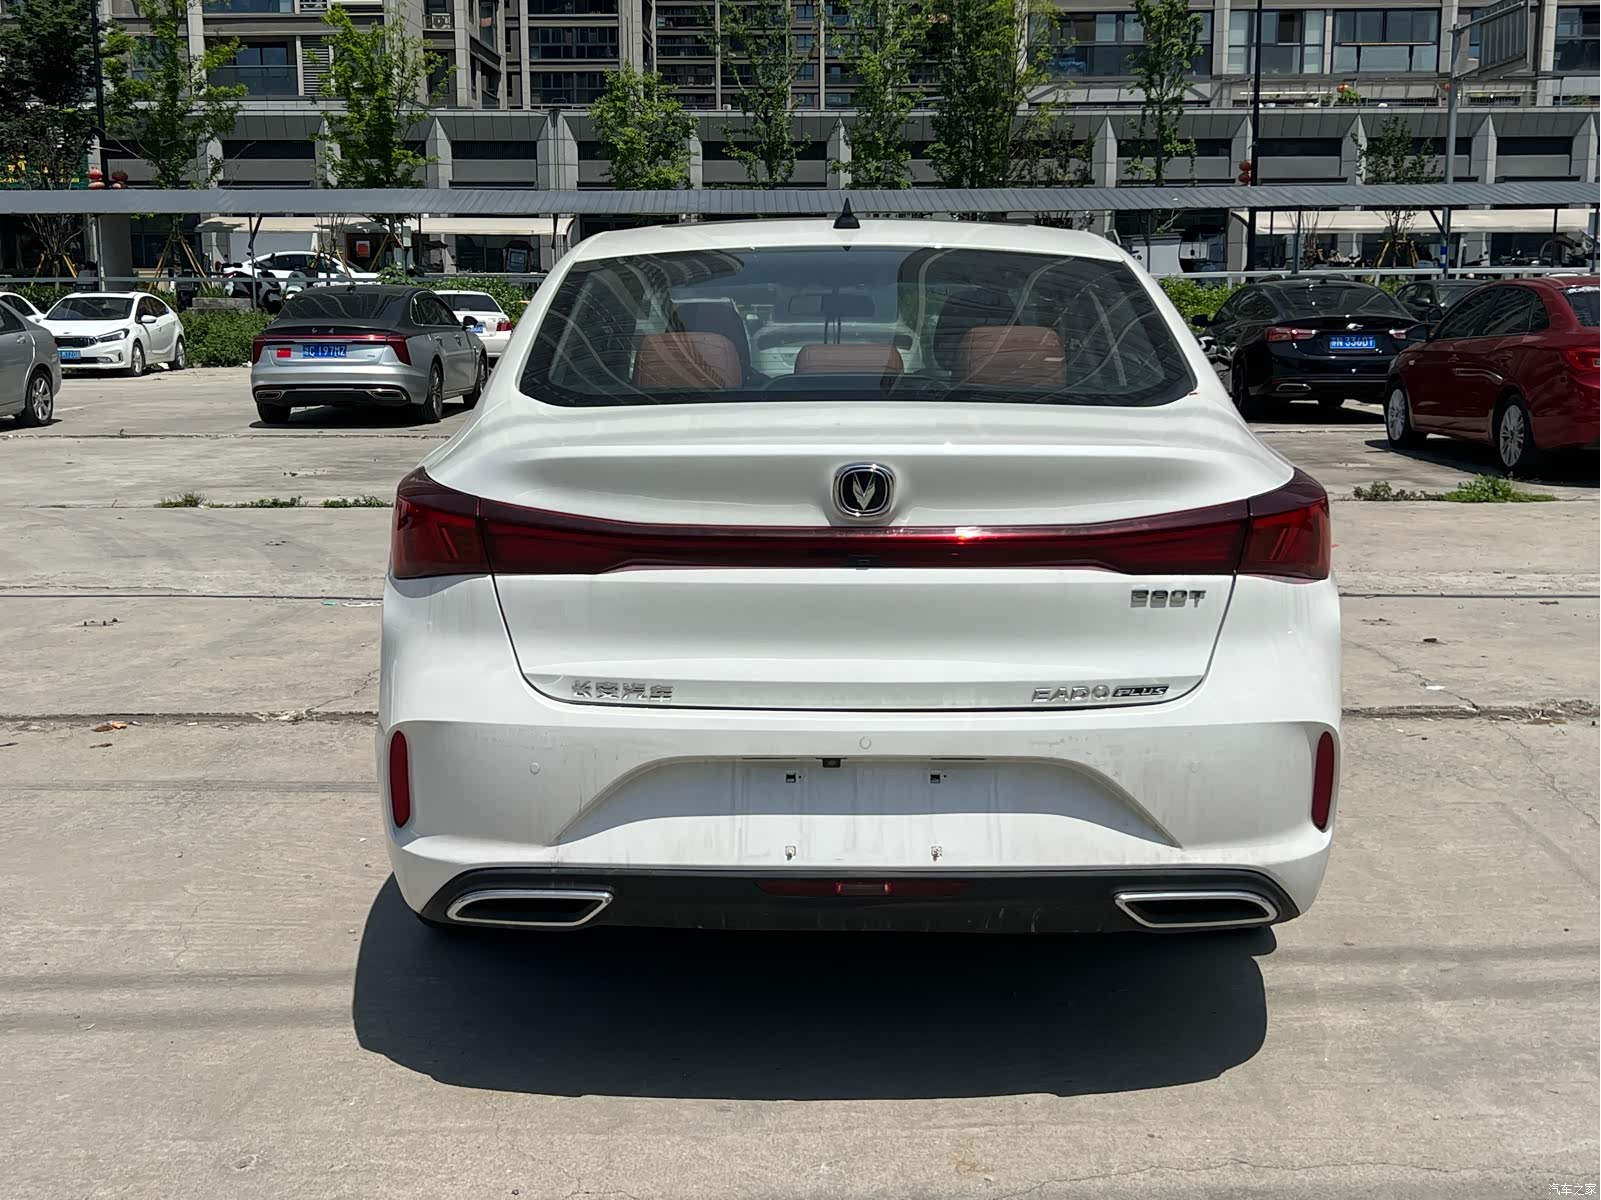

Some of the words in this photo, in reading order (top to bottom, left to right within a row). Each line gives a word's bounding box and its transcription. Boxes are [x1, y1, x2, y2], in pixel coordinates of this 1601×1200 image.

[571, 680, 674, 701] 长安汽车
[1031, 684, 1111, 702] EADO
[1112, 685, 1168, 698] PLUS
